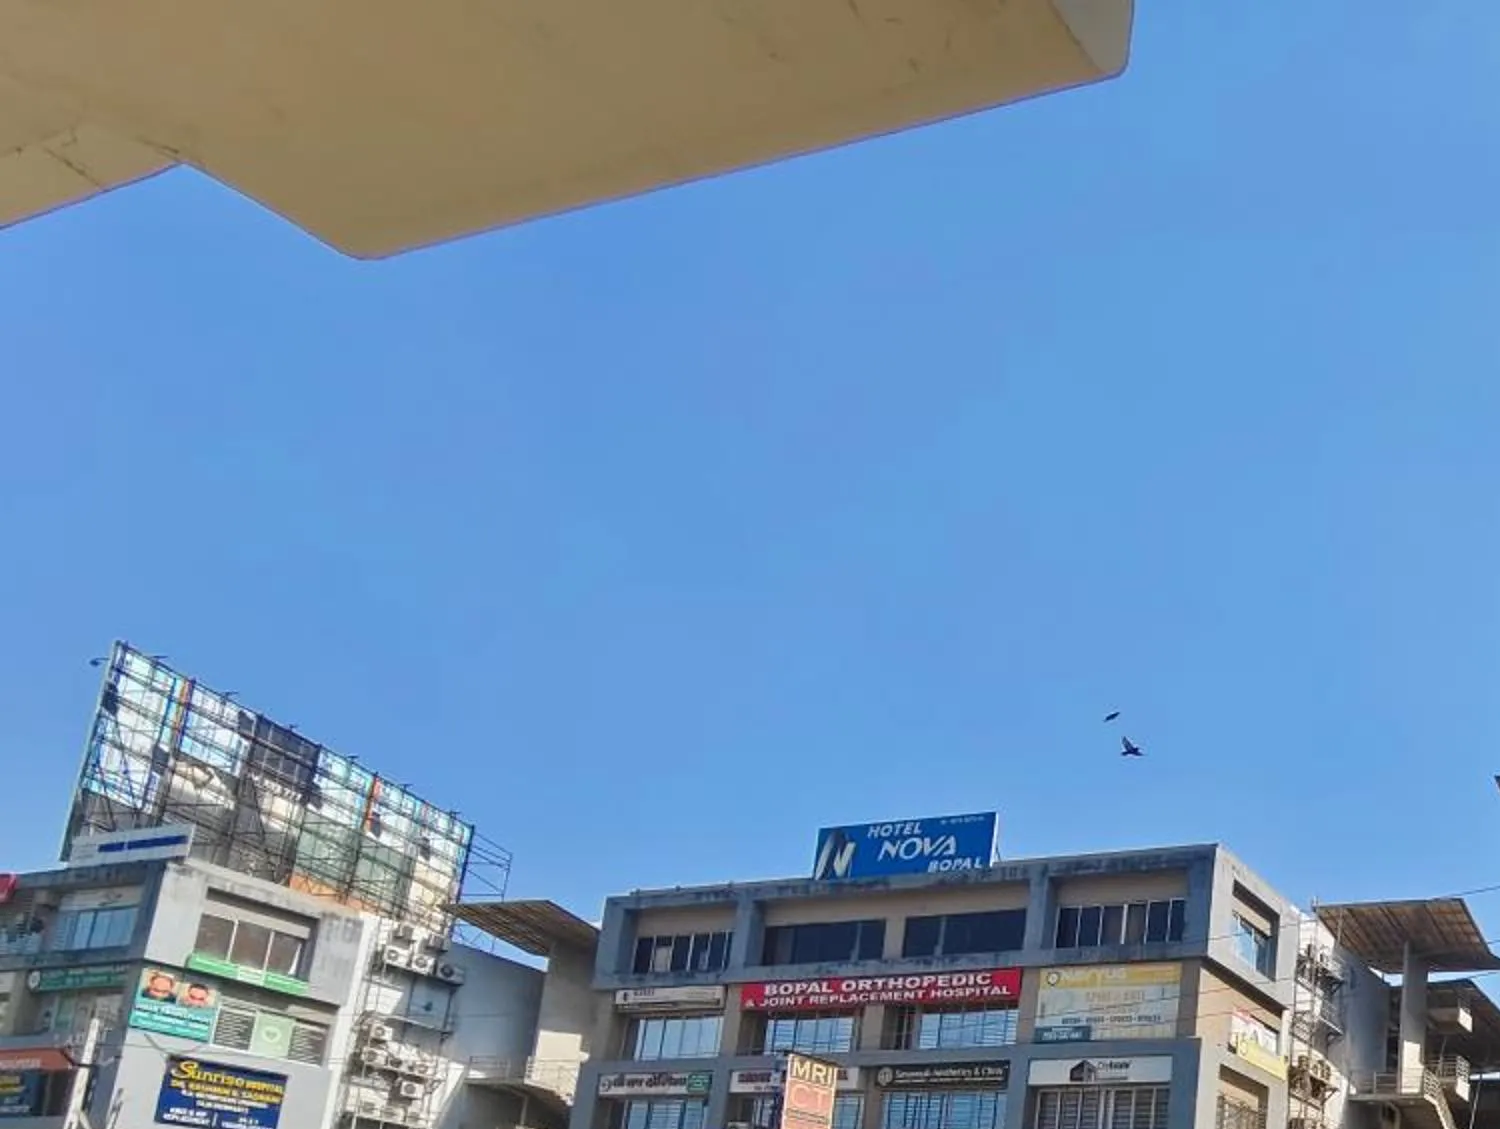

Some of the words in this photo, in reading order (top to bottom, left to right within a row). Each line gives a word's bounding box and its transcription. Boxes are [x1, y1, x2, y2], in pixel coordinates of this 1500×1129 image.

[868, 821, 923, 839] HOTEL
[877, 834, 957, 862] NOVA
[928, 857, 983, 874] BOPAL
[760, 995, 803, 1008] JOINT
[810, 988, 927, 1006] REPLACEMENT
[931, 985, 1012, 999] HOSPITAL
[763, 980, 834, 997] BOPAL
[841, 972, 992, 992] ORTHOPEDIC
[792, 1058, 834, 1086] MRI
[789, 1083, 828, 1110] CT
